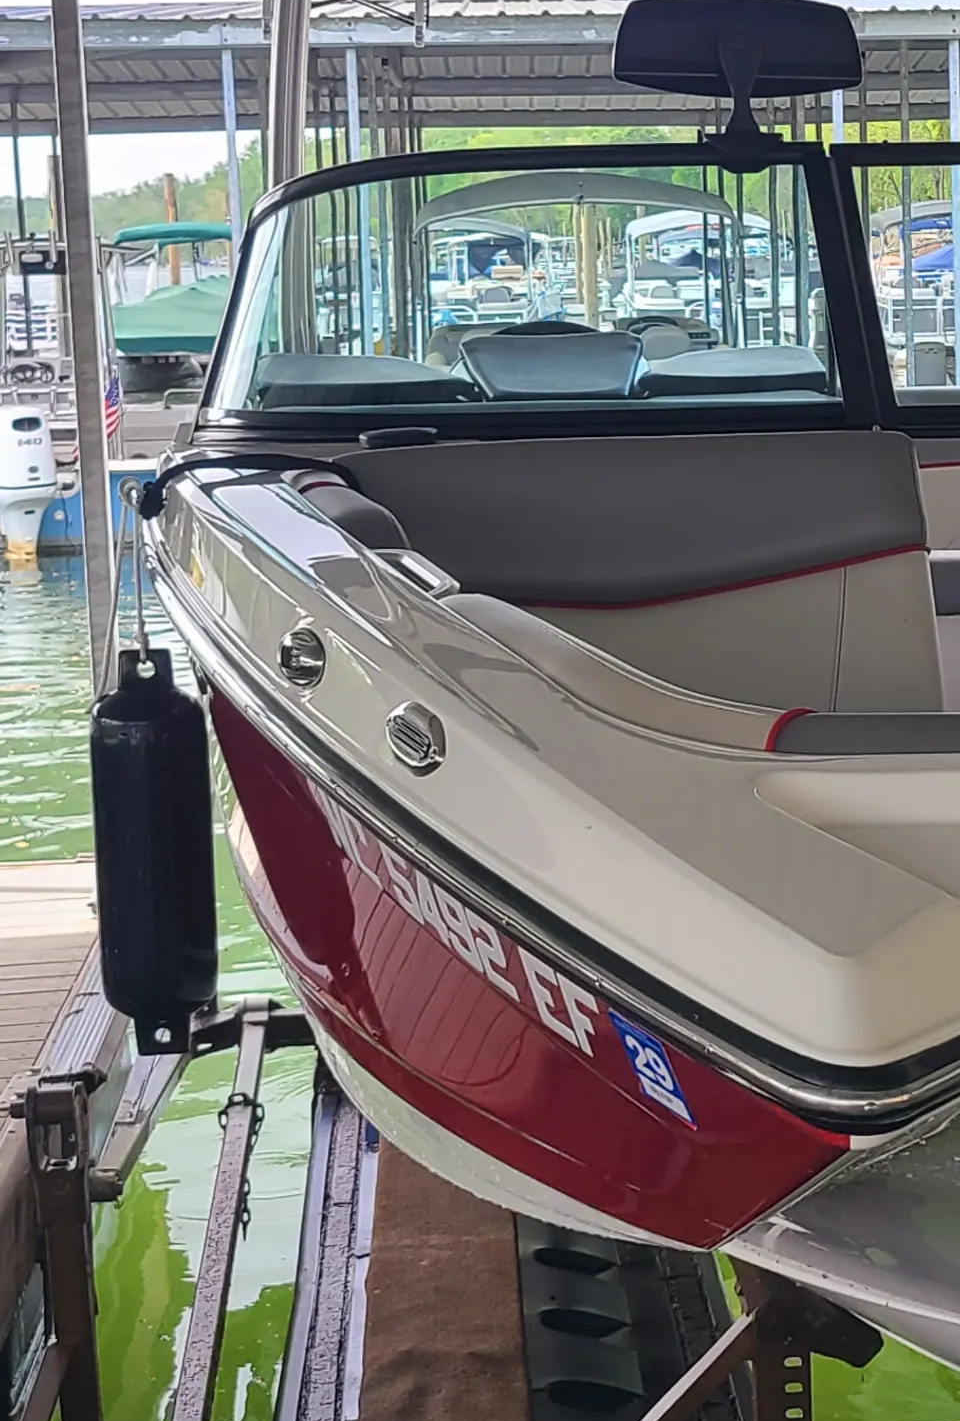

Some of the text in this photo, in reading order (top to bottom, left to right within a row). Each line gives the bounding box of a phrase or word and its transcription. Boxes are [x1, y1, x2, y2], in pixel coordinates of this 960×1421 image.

[378, 840, 521, 1004] 5492
[517, 945, 600, 1059] EF
[625, 1034, 675, 1092] 29
